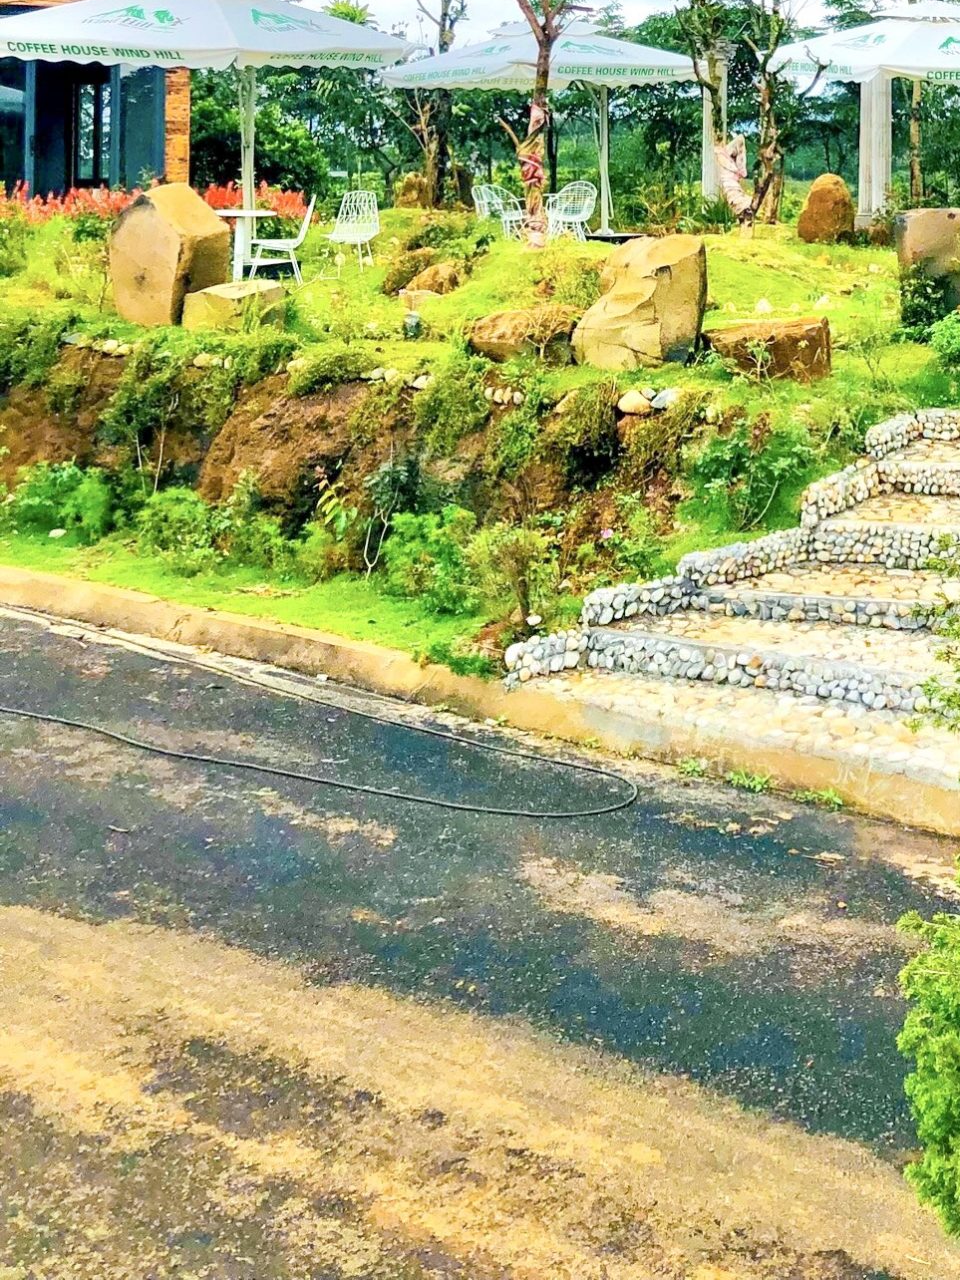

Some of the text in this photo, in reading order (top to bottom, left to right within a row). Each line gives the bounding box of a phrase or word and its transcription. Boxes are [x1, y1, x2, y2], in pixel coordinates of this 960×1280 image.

[7, 41, 185, 60] COFFEE HOUSE WIND HILL
[306, 52, 342, 61] HOUSE
[339, 52, 364, 61] WIND
[365, 53, 384, 63] HILL
[427, 70, 452, 80] HOUSE
[471, 66, 486, 75] HILL
[557, 66, 676, 77] COFFEE HOUSE WIND HILL
